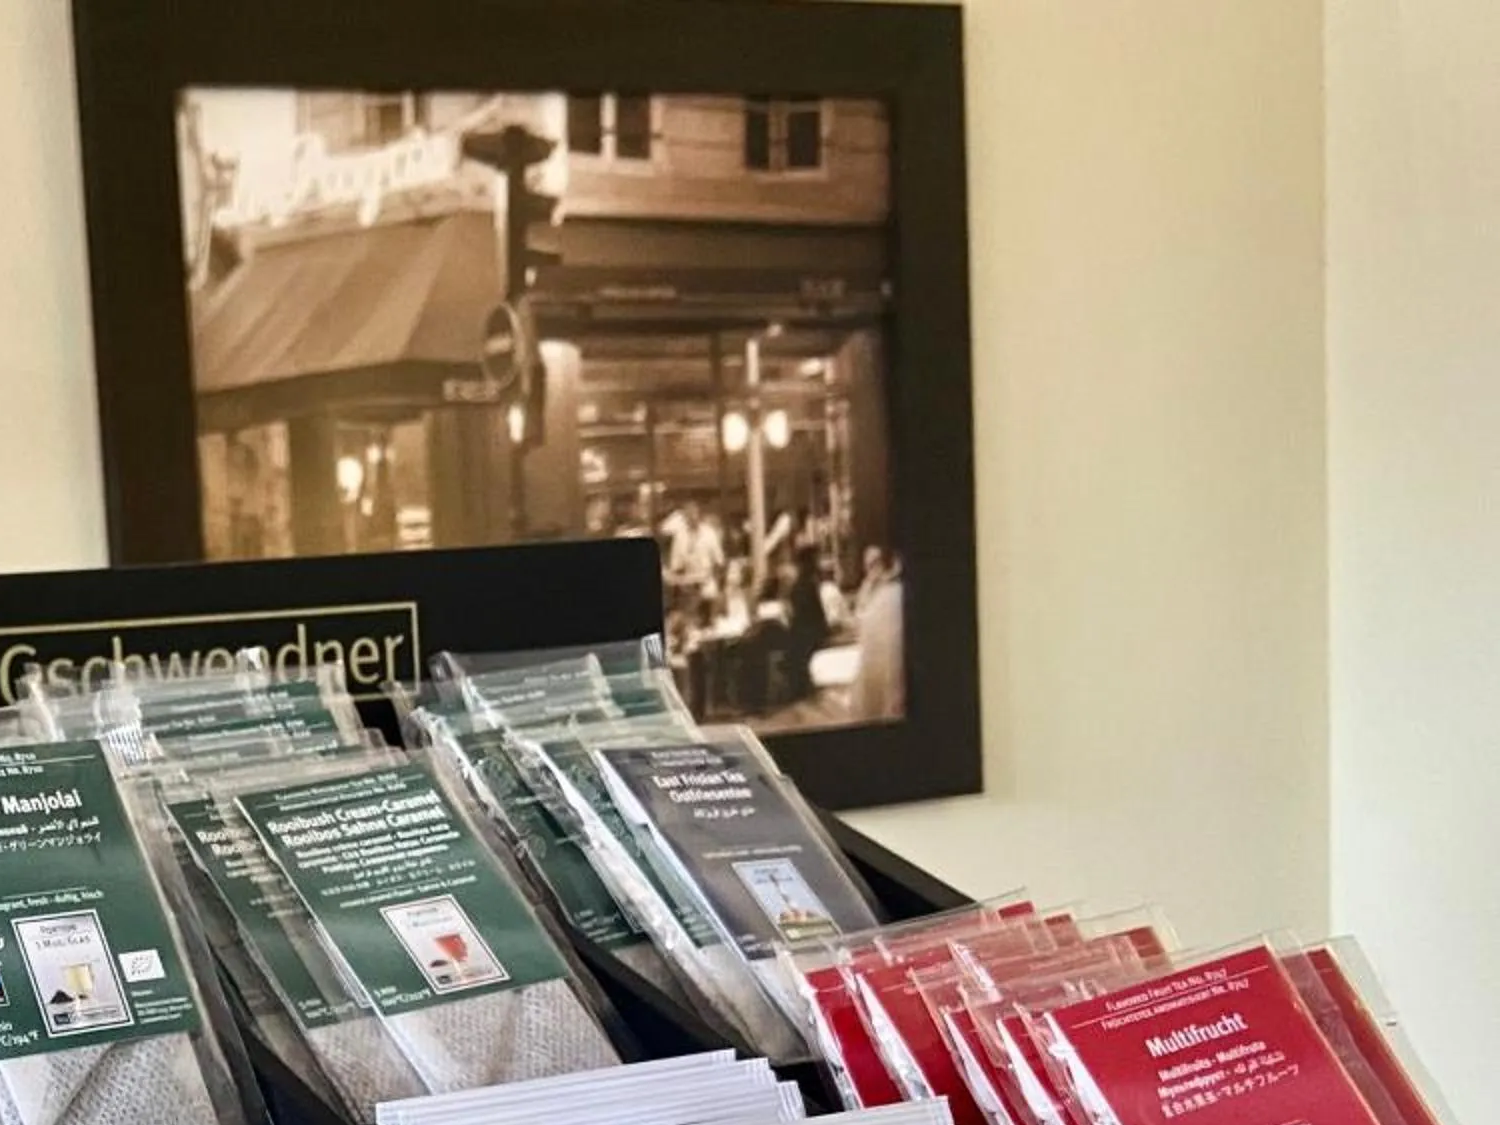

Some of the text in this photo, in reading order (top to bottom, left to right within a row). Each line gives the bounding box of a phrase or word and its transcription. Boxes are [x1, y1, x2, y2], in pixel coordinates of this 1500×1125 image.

[0, 624, 404, 706] Gschwendner
[1, 789, 83, 816] Manjolai
[1145, 1012, 1249, 1058] Multifrucht
